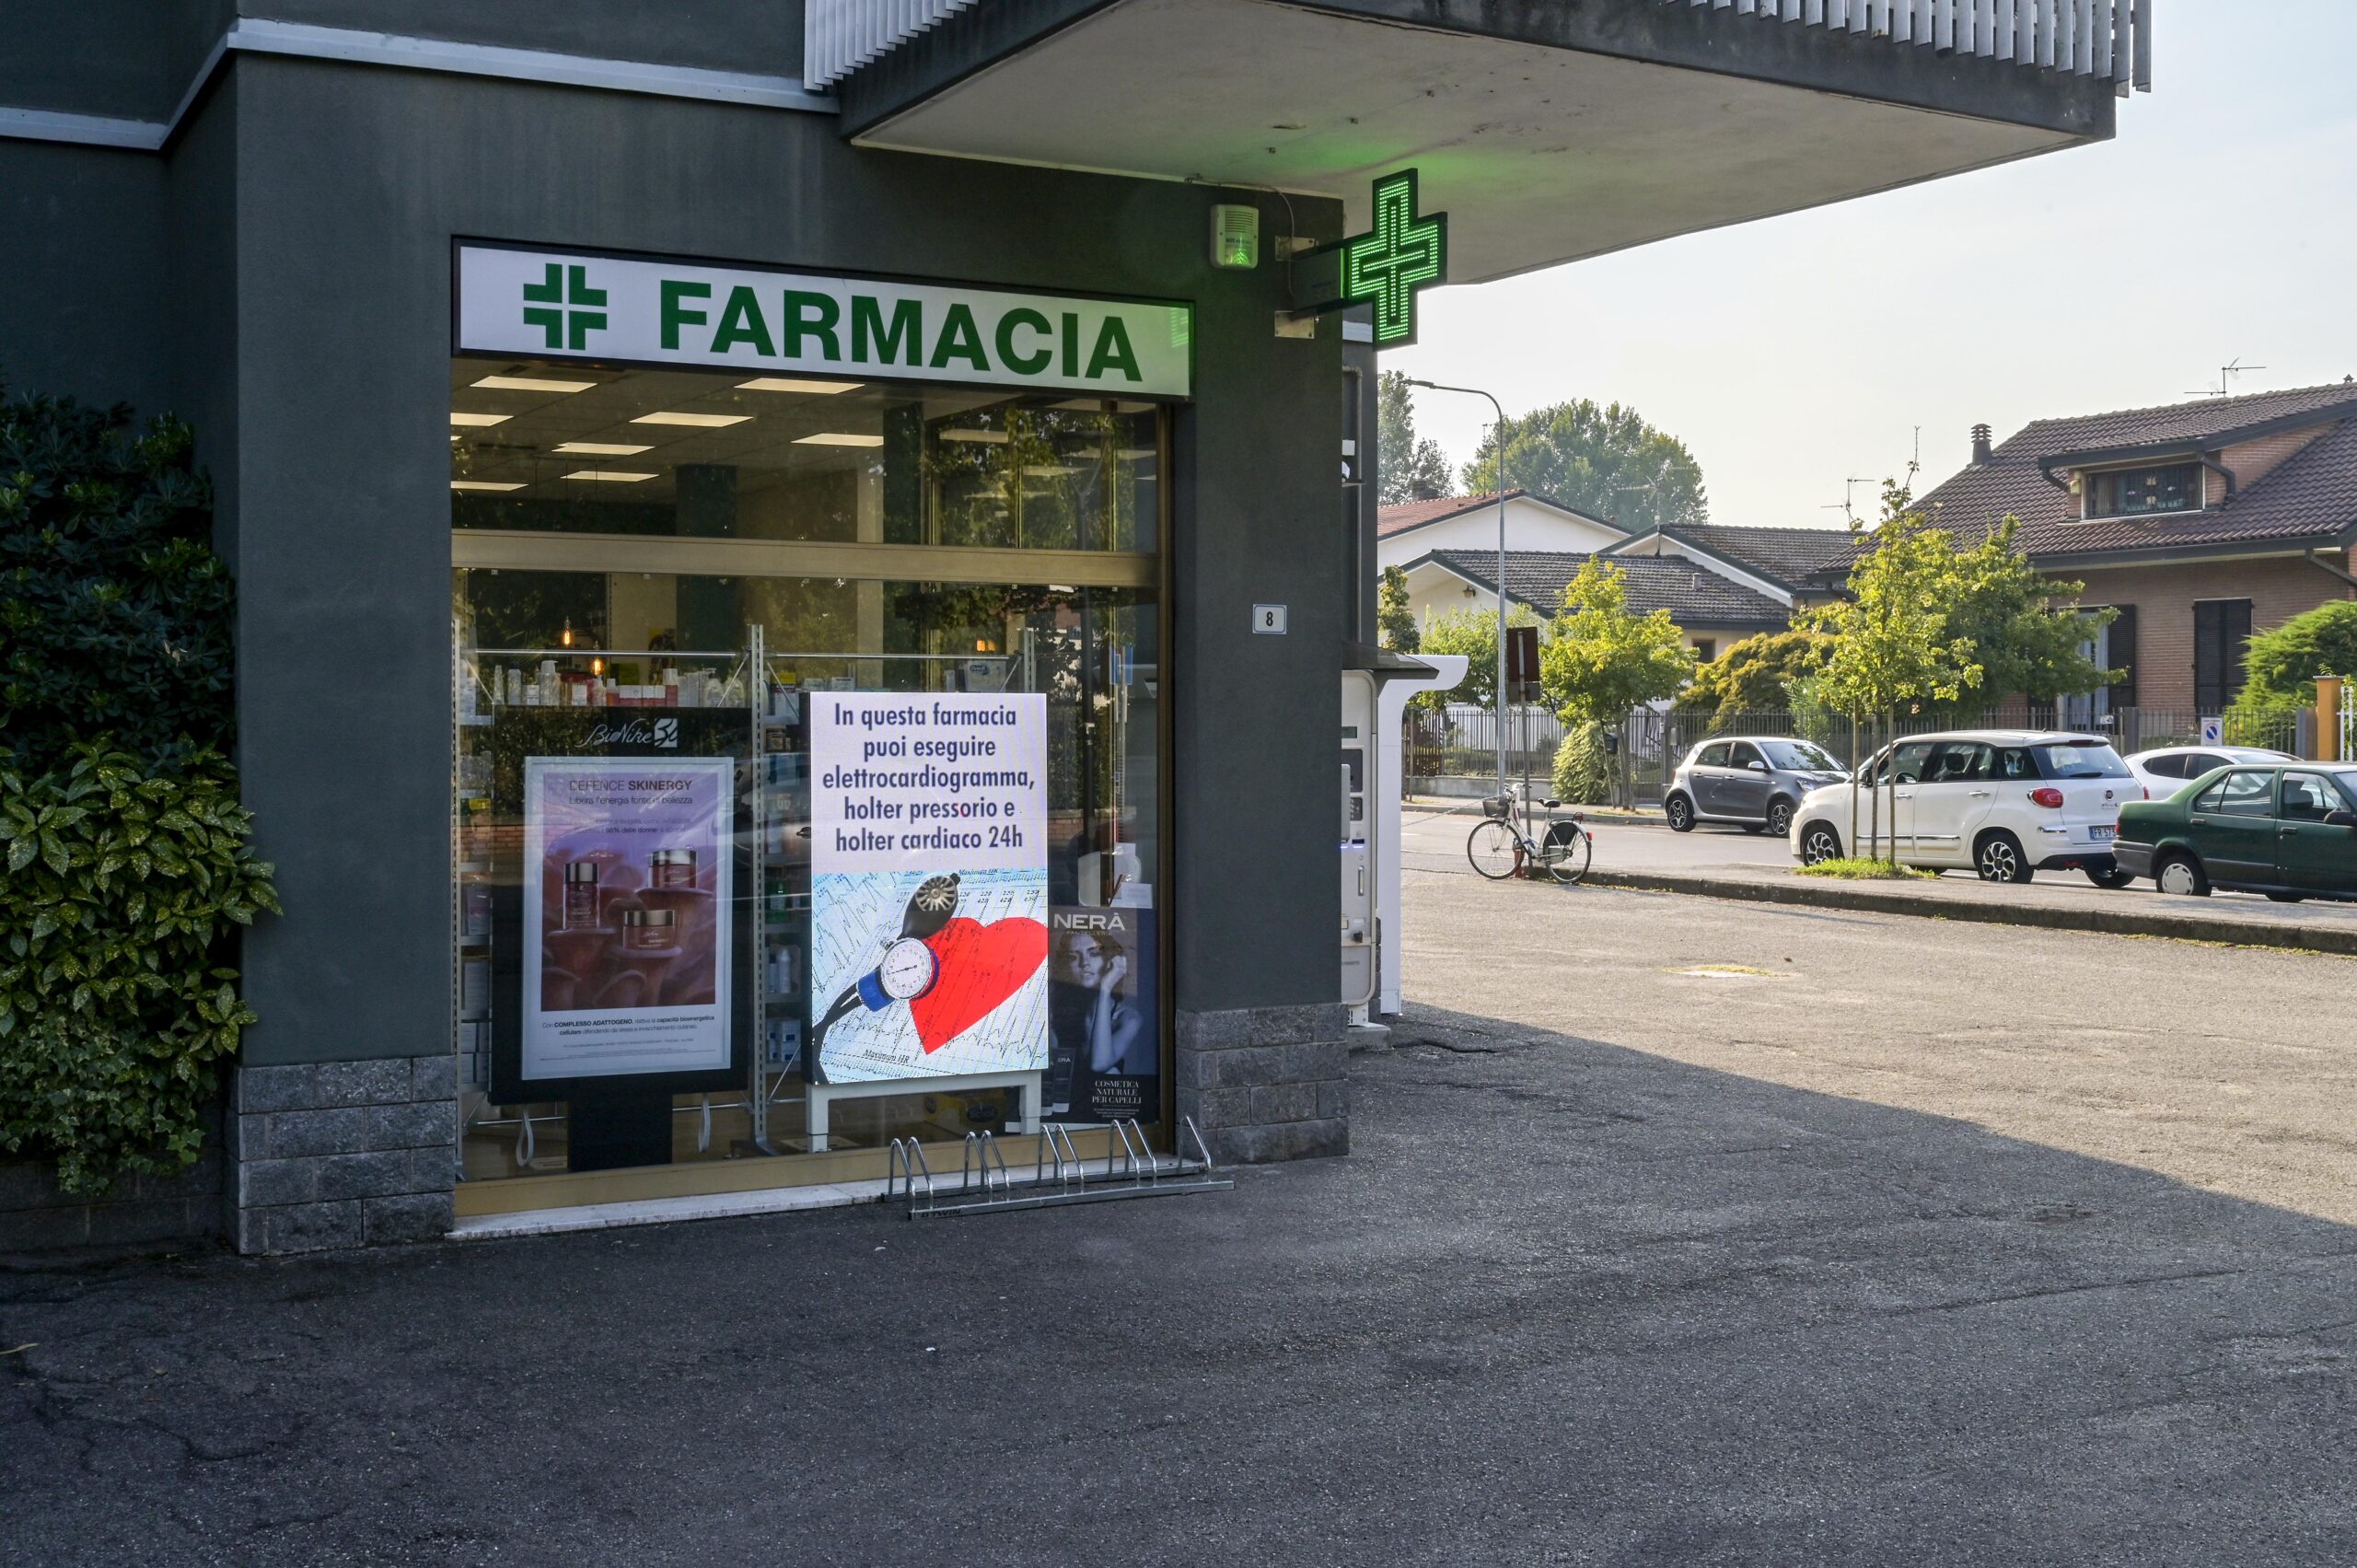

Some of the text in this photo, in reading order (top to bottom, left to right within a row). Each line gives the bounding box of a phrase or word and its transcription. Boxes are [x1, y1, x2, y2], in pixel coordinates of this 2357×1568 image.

[660, 279, 1142, 382] FARMACIA
[1265, 610, 1274, 627] 8
[834, 702, 1016, 731] In questa farmacia
[864, 736, 996, 762] puoi eseguire
[569, 780, 692, 791] DEFENCE SKINERGY
[822, 764, 1035, 793] elettrocardiogramma,
[569, 796, 594, 805] Libera
[661, 796, 693, 805] bellezza
[844, 796, 1016, 824] holter pressorio e
[836, 824, 1023, 852] holter cardiaco 24h
[553, 1019, 592, 1028] COMPLESSO
[863, 1048, 898, 1062] Maximum
[1095, 1080, 1139, 1088] COSMETICA
[1097, 1087, 1138, 1097] NATURALE
[1092, 1096, 1142, 1105] PER CAPELLI
